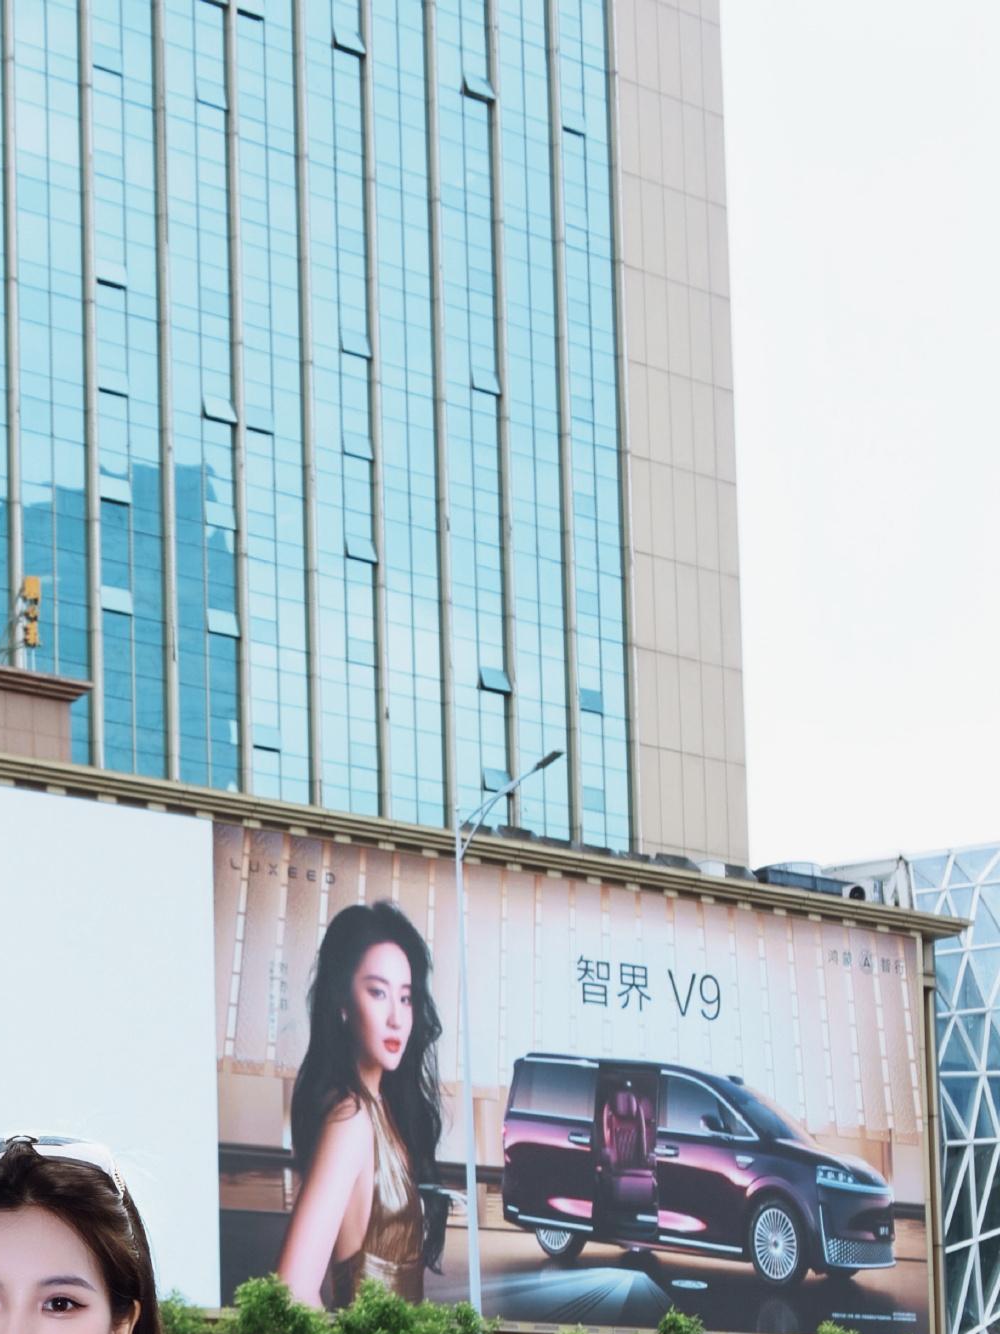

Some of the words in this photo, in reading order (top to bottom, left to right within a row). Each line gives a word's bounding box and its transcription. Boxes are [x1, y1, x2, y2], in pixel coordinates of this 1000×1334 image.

[230, 857, 337, 885] LUXEED
[577, 954, 652, 1012] 智界
[667, 968, 721, 1021] V9
